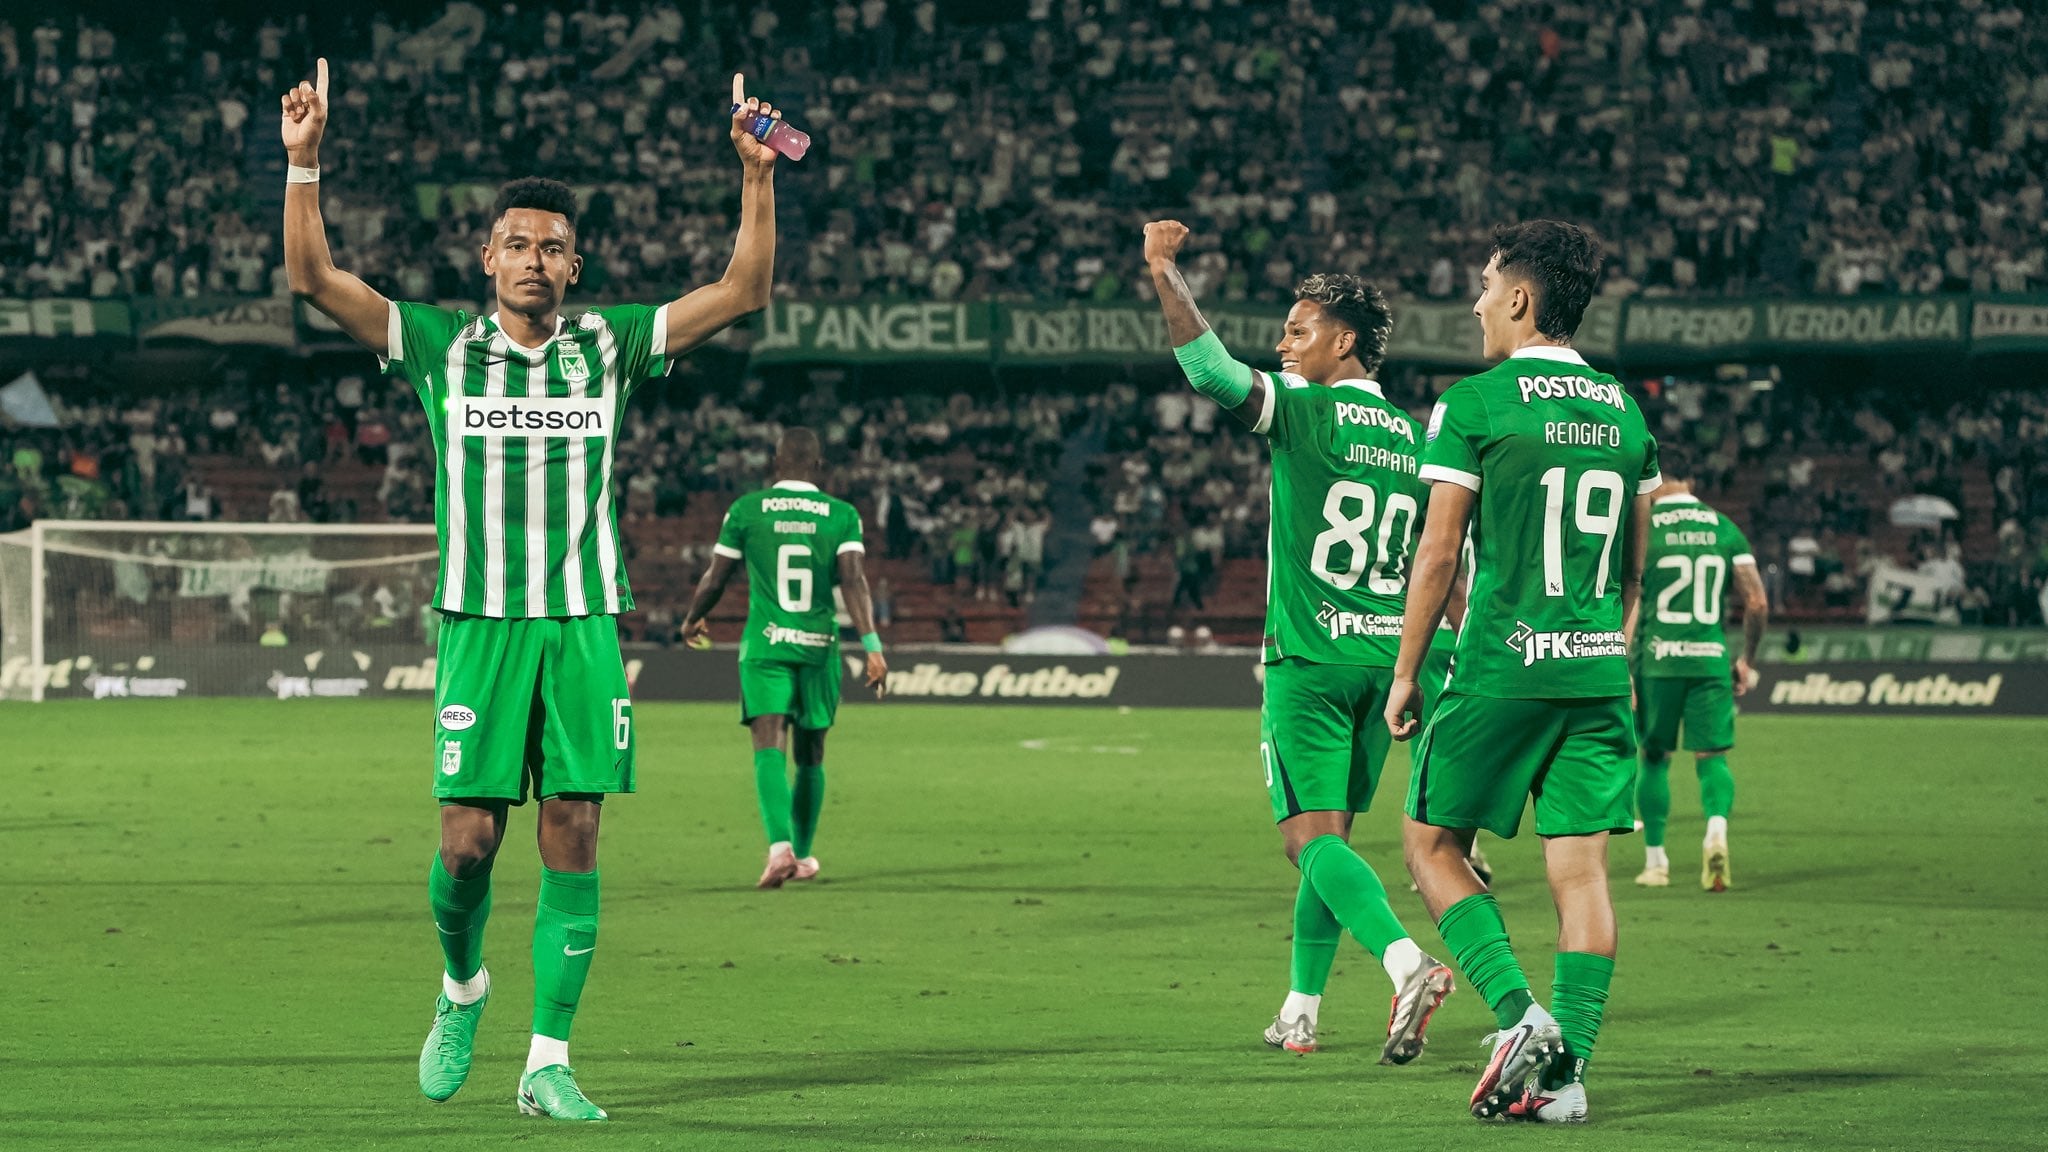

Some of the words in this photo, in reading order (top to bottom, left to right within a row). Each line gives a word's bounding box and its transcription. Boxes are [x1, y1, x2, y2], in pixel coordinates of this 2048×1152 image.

[1766, 303, 1958, 343] VERDOLAGA
[1517, 376, 1626, 412] POSTOBON
[465, 404, 602, 430] betsson
[1545, 421, 1620, 447] RENGIFO
[762, 497, 830, 517] POSTOBON
[1310, 480, 1417, 595] 80
[1540, 467, 1624, 599] 19
[777, 544, 813, 612] 6
[1656, 554, 1726, 625] 20
[1330, 612, 1370, 640] JFK
[1524, 632, 1574, 667] JFK
[887, 663, 979, 696] nike
[979, 663, 1120, 698] futbol
[1770, 672, 1866, 705] nike
[1867, 672, 2003, 706] futbol
[441, 711, 473, 722] ARESS
[611, 698, 632, 750] 16
